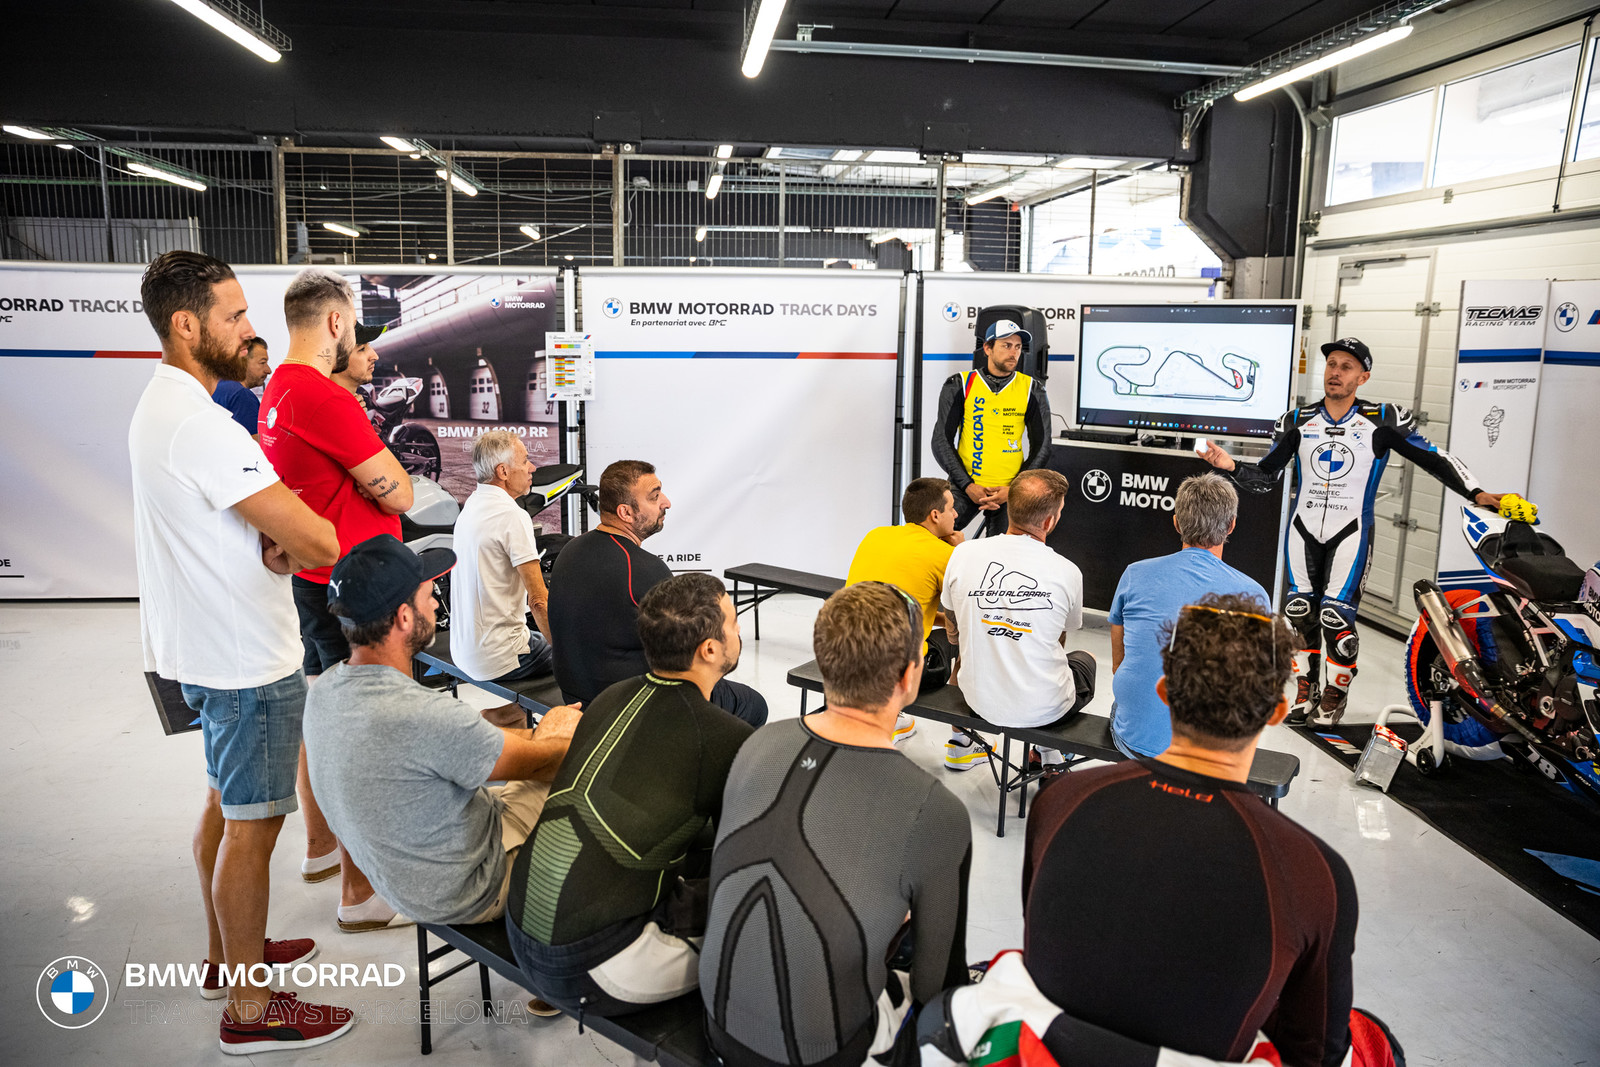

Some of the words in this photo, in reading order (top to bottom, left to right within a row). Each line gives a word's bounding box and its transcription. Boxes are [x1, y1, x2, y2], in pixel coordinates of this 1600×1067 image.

[69, 299, 129, 313] TRACK
[630, 302, 672, 314] BMW
[679, 302, 774, 315] MOTORRAD
[780, 304, 834, 316] TRACK
[837, 304, 877, 317] DAYS
[1466, 306, 1543, 321] TECMAS
[642, 319, 687, 328] partenariat
[482, 401, 490, 414] 32
[437, 426, 474, 438] BMW
[529, 426, 549, 438] RR
[971, 396, 986, 477] TRACKDAYS
[1121, 472, 1170, 492] BMW
[1119, 490, 1176, 512] MOTO
[1313, 502, 1349, 511] AVANISTA
[677, 553, 702, 562] RIDE
[967, 589, 986, 597] LES
[987, 627, 1023, 641] 2022
[1527, 743, 1558, 780] 18
